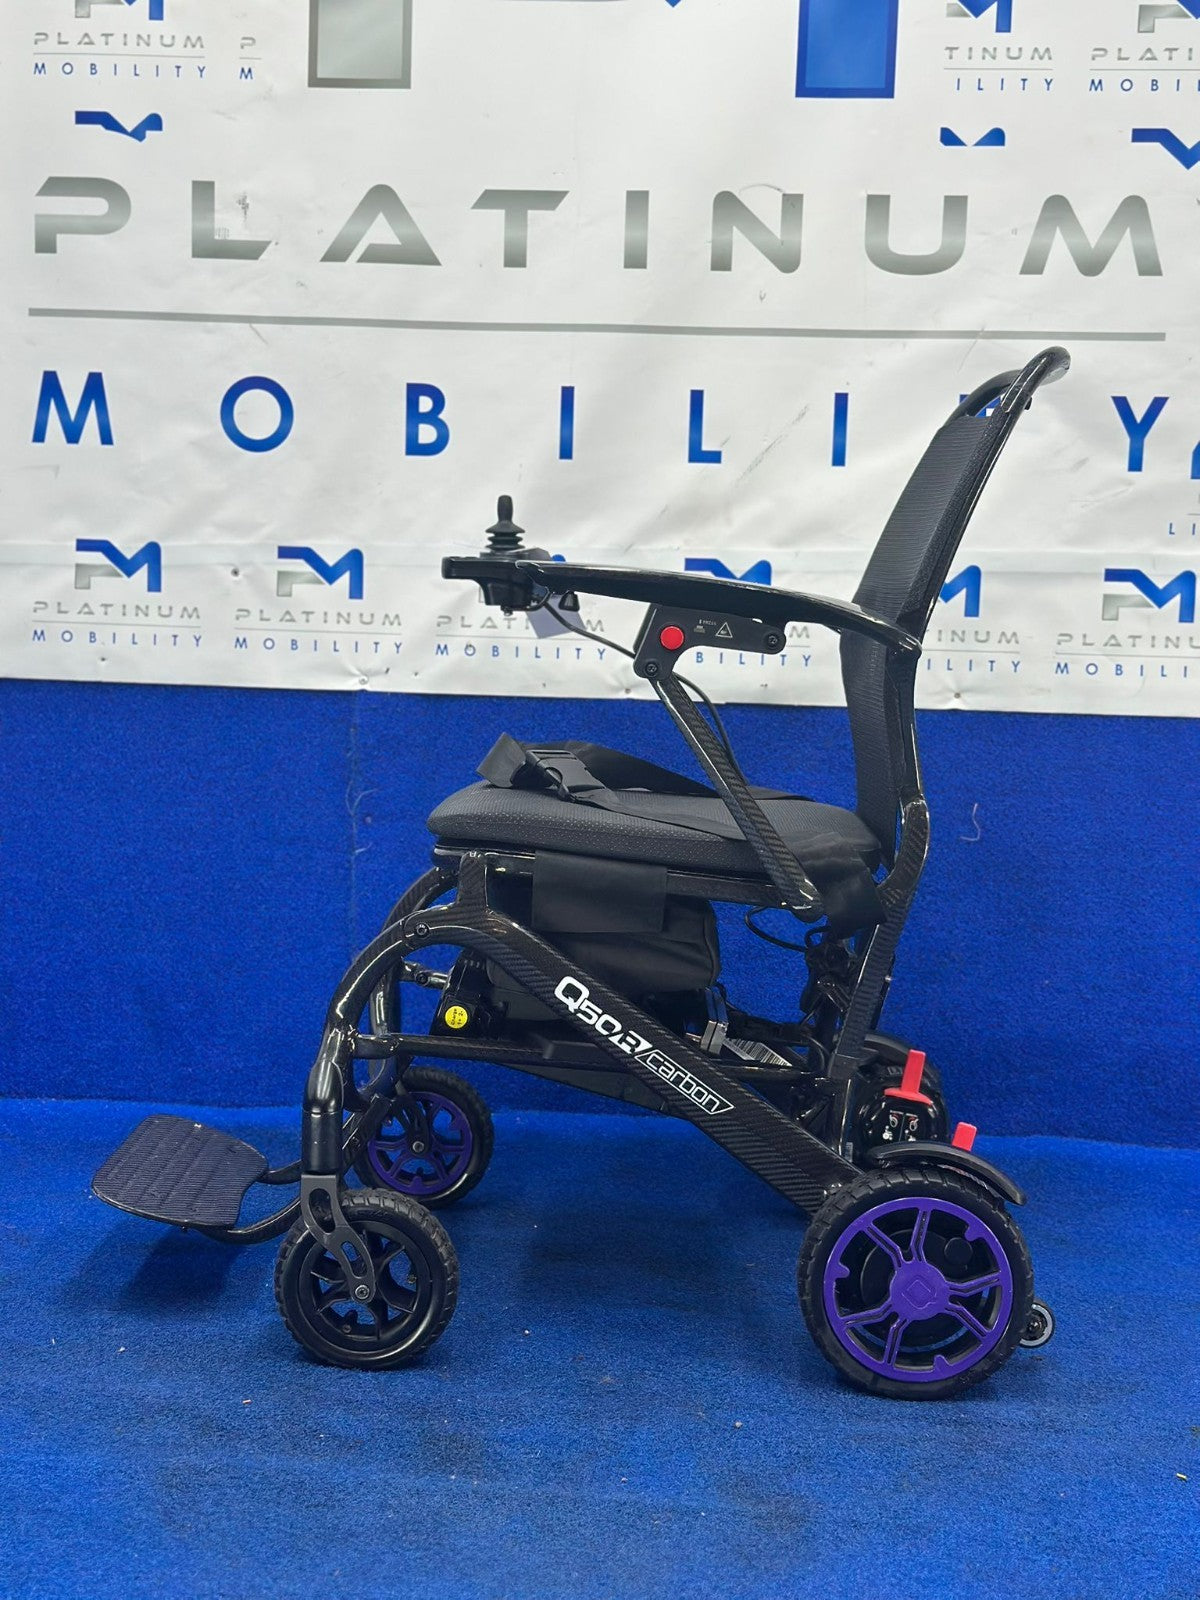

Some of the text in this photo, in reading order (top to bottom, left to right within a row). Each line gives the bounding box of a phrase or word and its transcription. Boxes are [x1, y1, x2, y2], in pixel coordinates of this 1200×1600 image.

[33, 32, 205, 49] PLATINUM
[944, 46, 1053, 61] TINUM
[1091, 47, 1200, 61] PLATI
[33, 62, 206, 79] MOBILITY
[956, 78, 1054, 92] ILITY
[34, 176, 1163, 278] PLATINUM
[32, 370, 1169, 472] MOBILIY
[33, 601, 201, 619] PLATINUM
[235, 608, 402, 626] PLATINUM
[436, 615, 605, 633] PLATIM
[32, 629, 202, 647] MOBILITY
[234, 637, 402, 654] MOBILITY
[926, 629, 1020, 645] INUM
[1056, 633, 1200, 649] PLATINU
[435, 643, 606, 660] MOBILITY
[695, 651, 811, 667] BILITY
[1055, 662, 1188, 678] MOBILI
[645, 1052, 721, 1112] carbon
